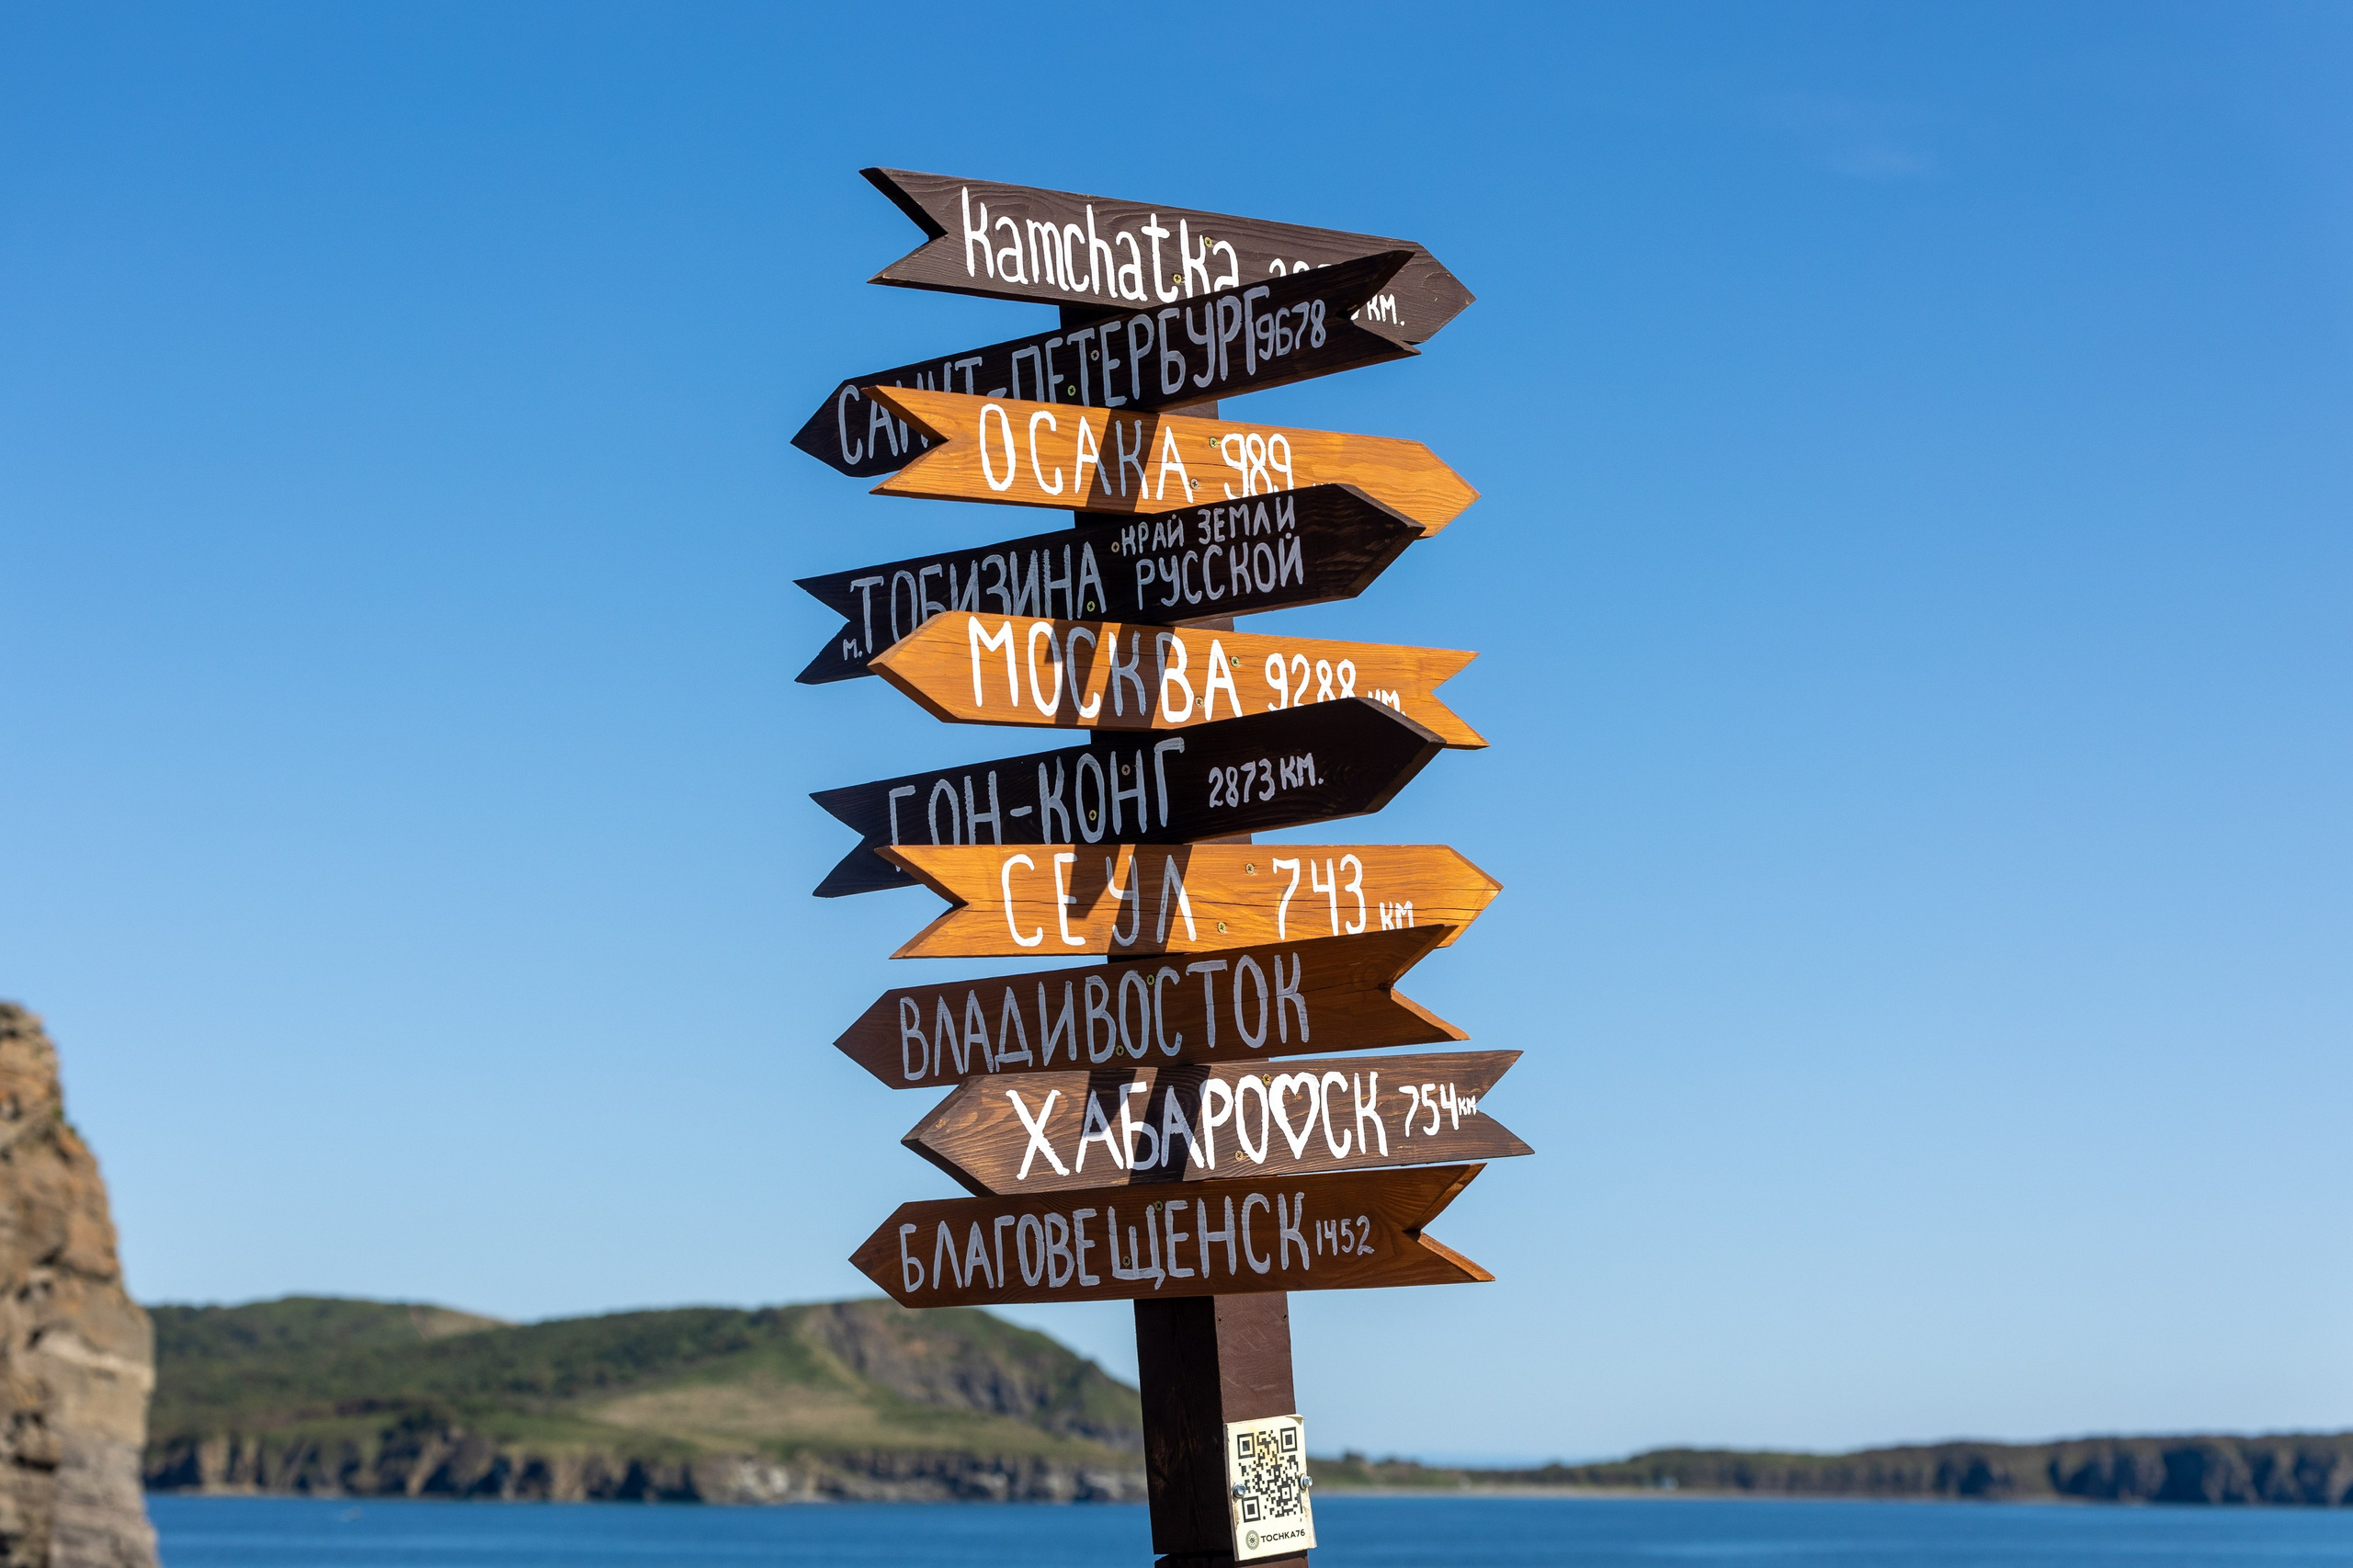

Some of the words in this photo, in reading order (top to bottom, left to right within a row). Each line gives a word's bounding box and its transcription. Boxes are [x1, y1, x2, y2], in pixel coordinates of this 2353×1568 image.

[1256, 298, 1326, 359] 9678
[978, 403, 1211, 504] ОСАКА
[1221, 432, 1294, 501] 989
[1121, 514, 1185, 556] КРАЙ
[1197, 494, 1296, 545] ЗЕМЛИ
[1135, 532, 1304, 611] РУССКОЙ
[849, 540, 1107, 654] ТОБИЗИНА
[968, 615, 1244, 724] МОСКВА
[1265, 652, 1357, 711] 9288
[888, 736, 1185, 871] ГОН-КОНГ
[1208, 758, 1276, 808] 2873
[1000, 853, 1198, 948] СЕУЛ
[1272, 853, 1367, 940] 743
[899, 951, 1311, 1081] ВЛАДИВОСТОК
[898, 1191, 1310, 1293] БЛАГОВЕЩЕНСК
[1315, 1214, 1375, 1256] 1452
[1260, 1528, 1306, 1543] TOCHKA76
